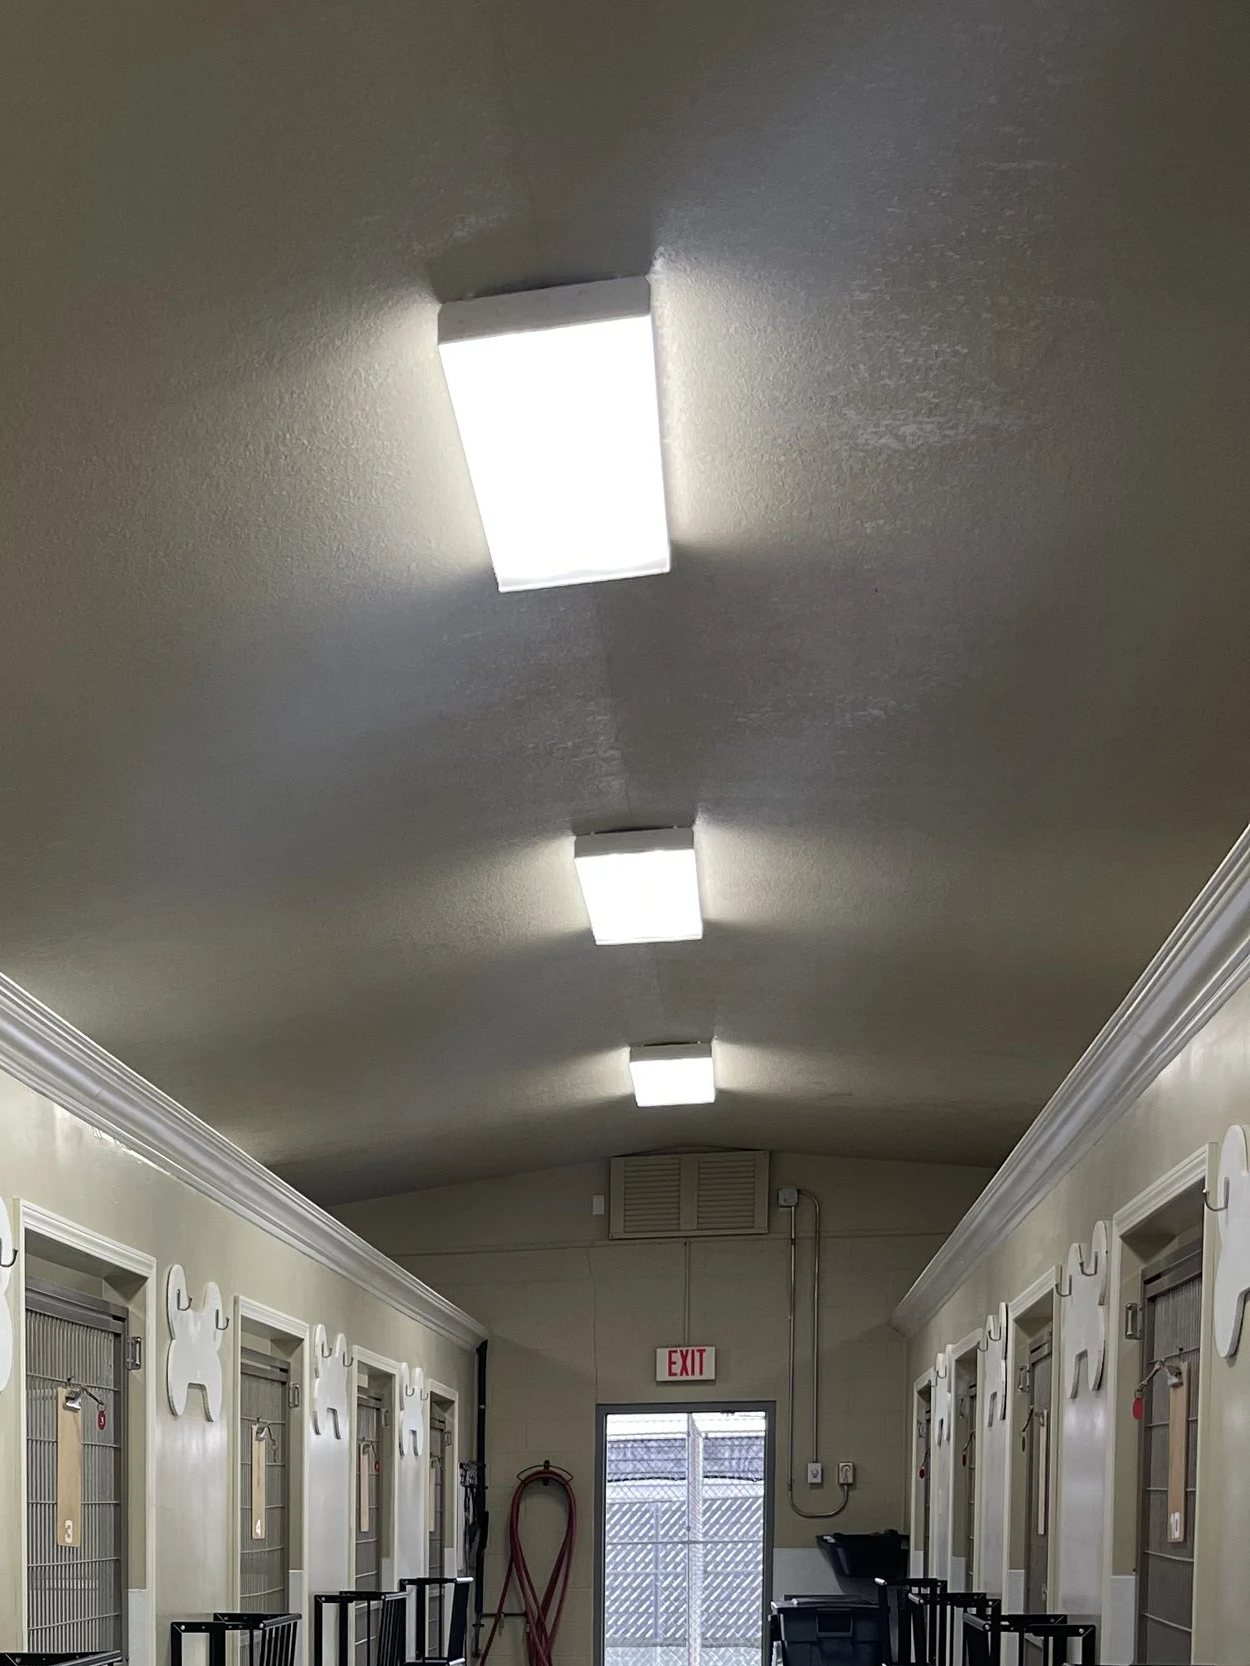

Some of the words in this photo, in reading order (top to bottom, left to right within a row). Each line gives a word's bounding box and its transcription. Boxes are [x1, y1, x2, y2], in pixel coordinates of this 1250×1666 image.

[668, 1349, 706, 1377] EXIT
[65, 1520, 73, 1543] 3
[256, 1519, 261, 1537] 4
[1170, 1512, 1180, 1539] 10
